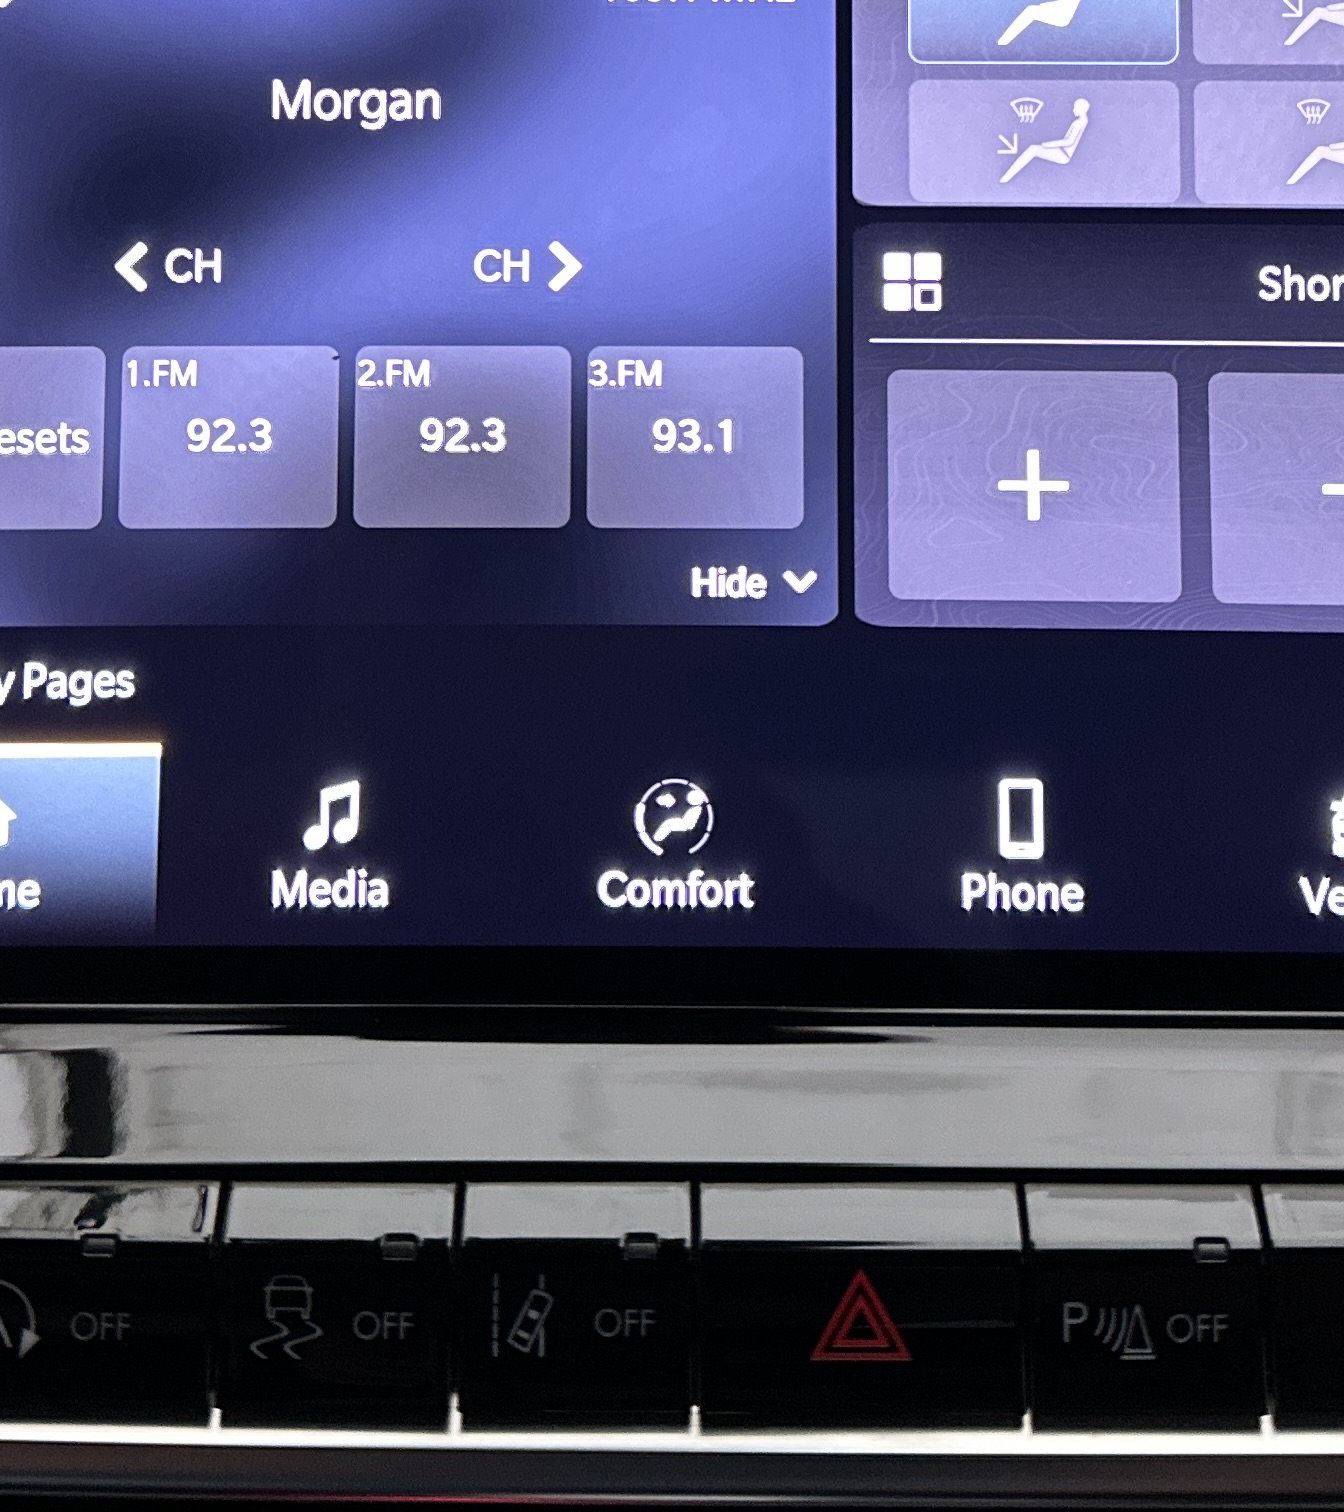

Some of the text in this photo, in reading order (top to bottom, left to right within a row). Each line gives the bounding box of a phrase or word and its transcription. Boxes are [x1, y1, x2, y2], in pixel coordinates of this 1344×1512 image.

[270, 77, 443, 132] Morgan
[163, 246, 223, 285] CH
[472, 247, 531, 284] CH
[126, 358, 199, 389] 1.FM
[356, 357, 432, 389] 2.FM
[587, 358, 664, 388] 3.FM
[185, 416, 274, 454] 92.3
[418, 416, 508, 455] 92.3
[651, 417, 734, 455] 93.1
[690, 564, 769, 601] Hide
[22, 660, 137, 708] Pages
[270, 866, 390, 911] Media
[596, 867, 757, 911] Comfort
[960, 869, 1086, 914] Phone
[69, 1310, 131, 1342] OFF
[352, 1309, 415, 1342] OFF
[593, 1307, 656, 1339] OFF
[1165, 1312, 1229, 1345] OFF
